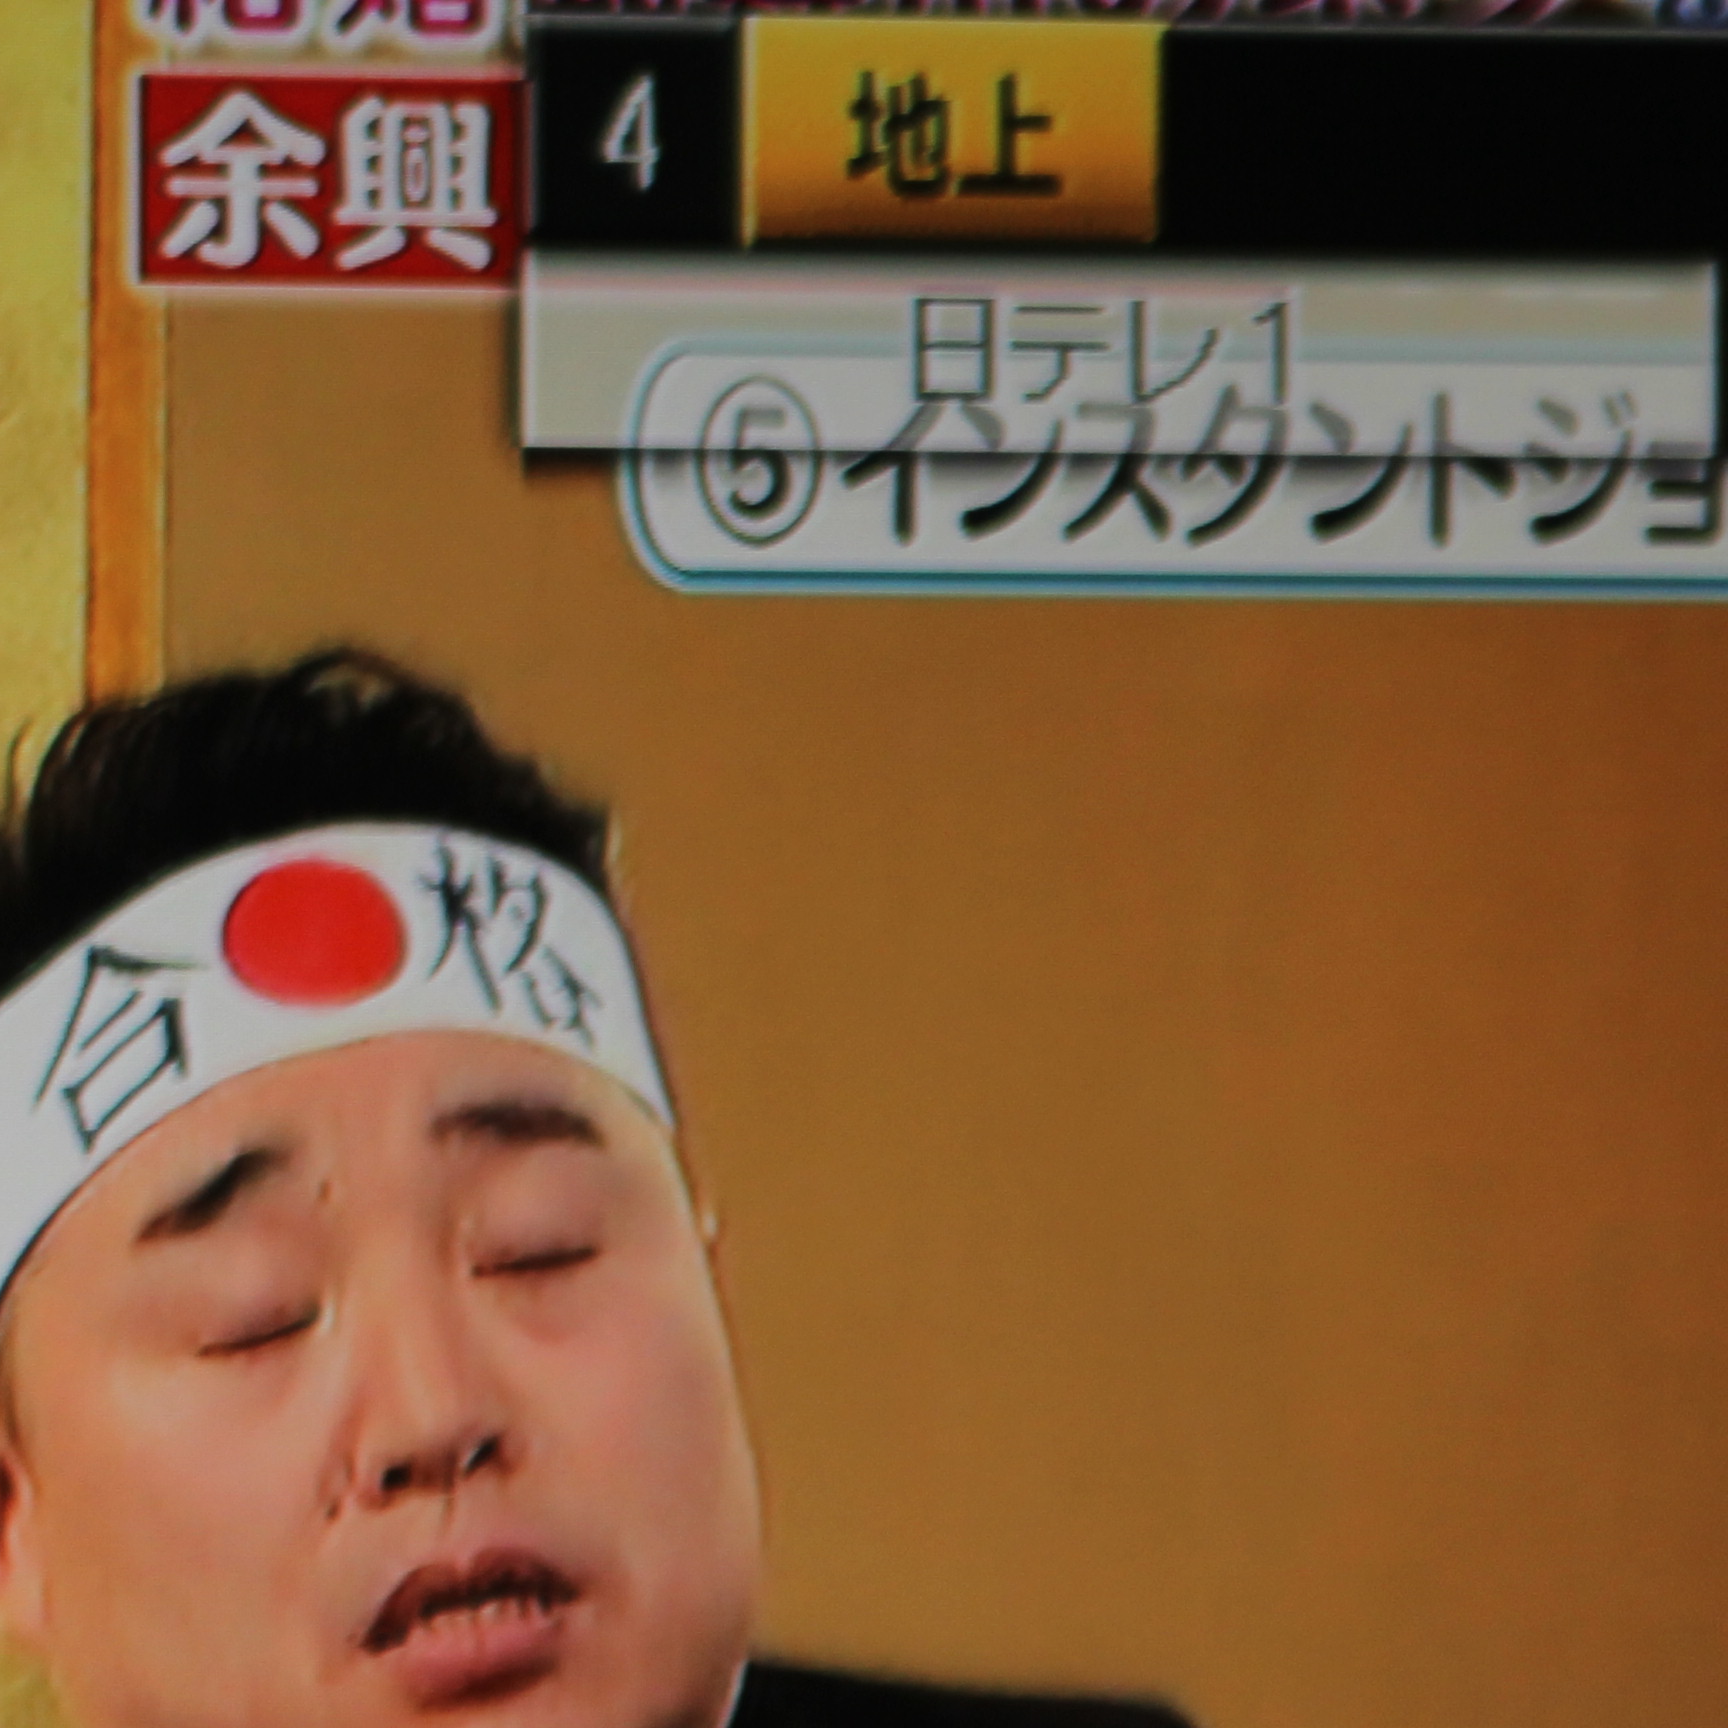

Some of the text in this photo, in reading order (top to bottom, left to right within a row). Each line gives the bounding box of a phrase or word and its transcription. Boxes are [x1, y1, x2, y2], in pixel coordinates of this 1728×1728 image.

[157, 88, 500, 272] 余興
[602, 74, 660, 191] 4
[846, 70, 1063, 198] 地上
